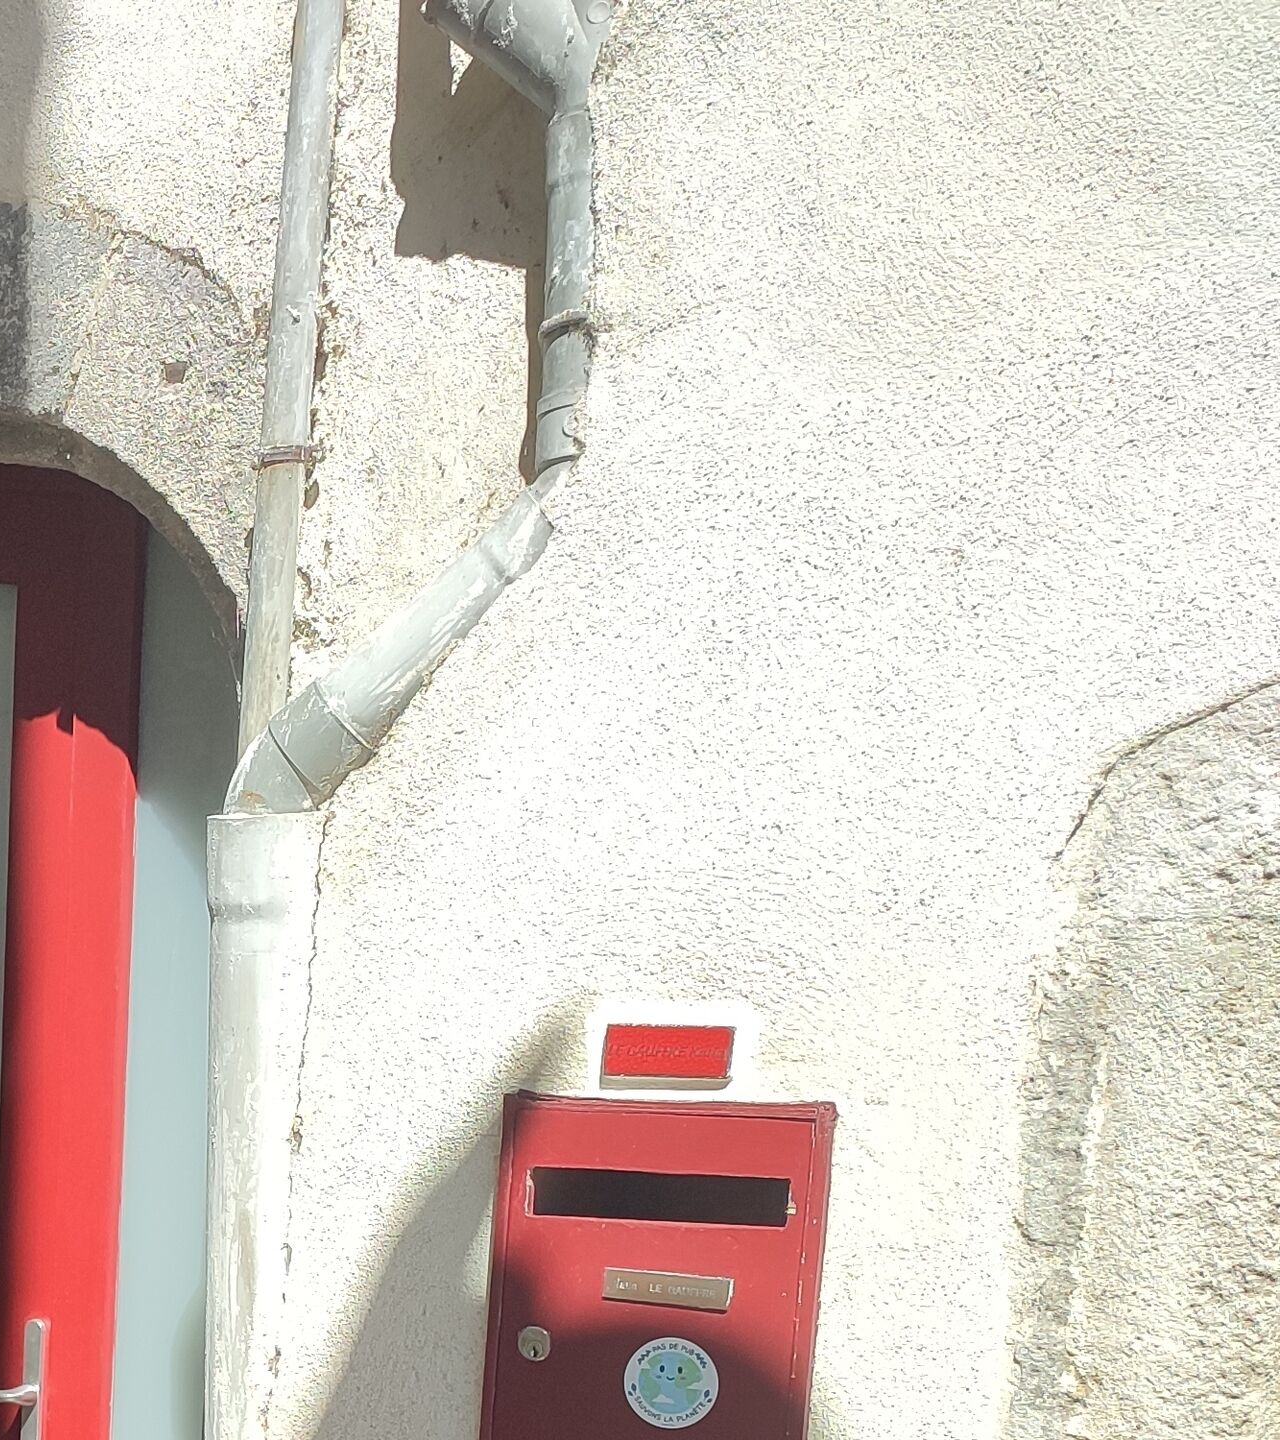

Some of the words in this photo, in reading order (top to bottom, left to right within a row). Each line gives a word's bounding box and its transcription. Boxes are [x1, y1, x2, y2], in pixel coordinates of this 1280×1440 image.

[648, 1283, 663, 1294] LE
[652, 1342, 667, 1353] PAS
[668, 1343, 680, 1351] DE
[680, 1344, 695, 1356] PUB
[634, 1395, 663, 1421] SAUVONS
[663, 1415, 675, 1423] LA
[676, 1402, 707, 1422] PLANÈTE
